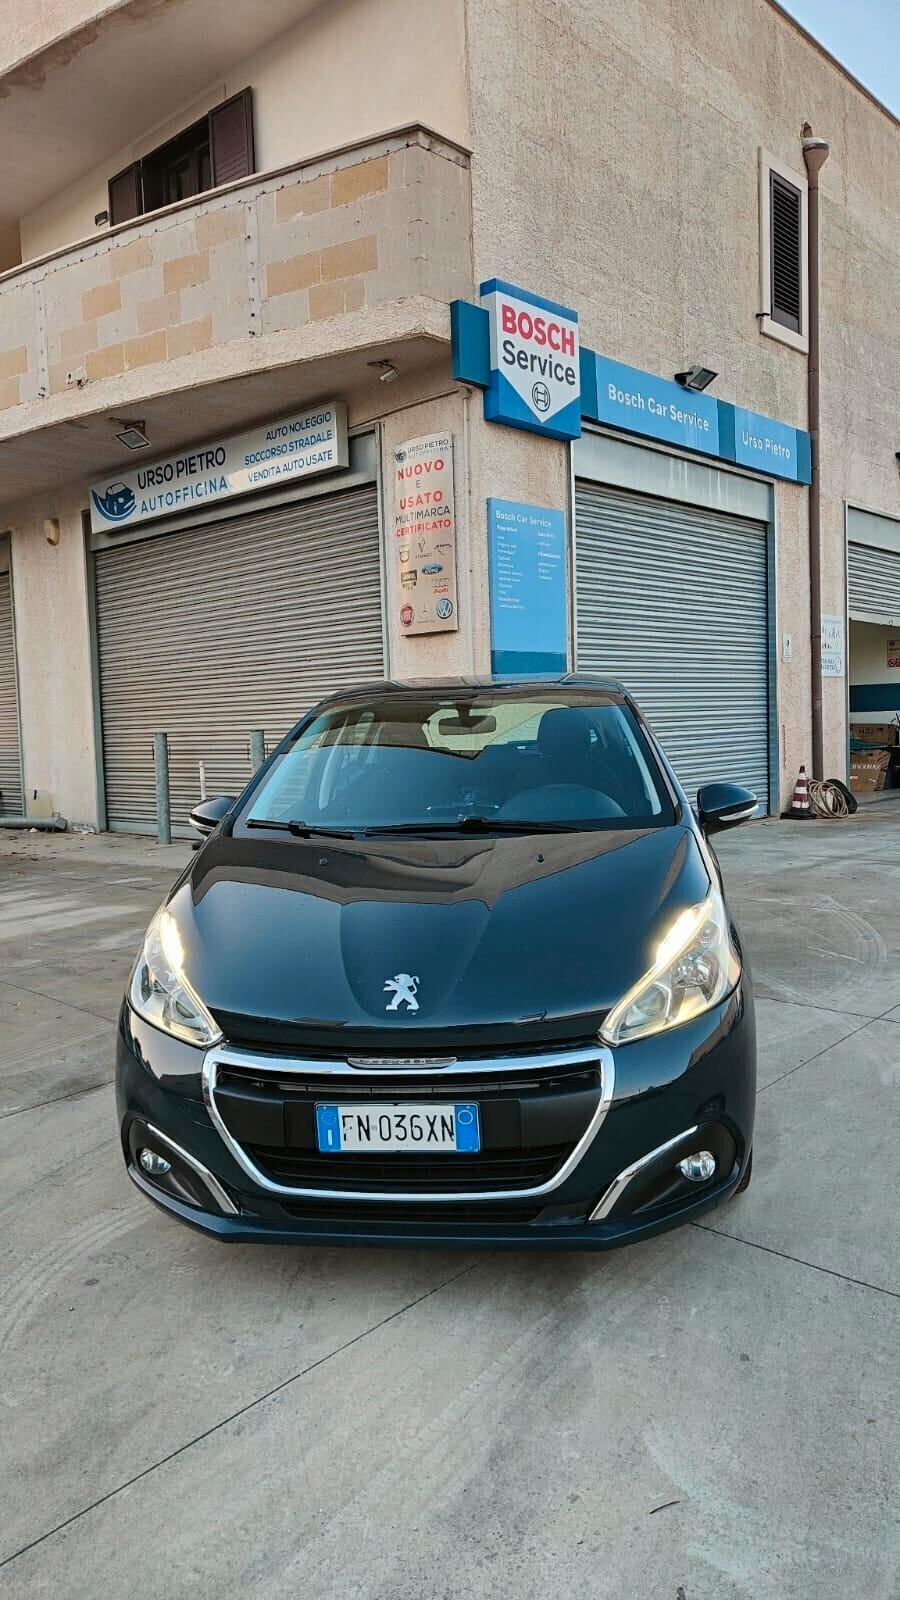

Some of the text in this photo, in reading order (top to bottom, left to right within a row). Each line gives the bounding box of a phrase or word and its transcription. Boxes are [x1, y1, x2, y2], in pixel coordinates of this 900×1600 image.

[501, 304, 575, 357] BOSCH
[502, 340, 576, 386] Service
[607, 383, 710, 432] Bosch Car Service
[266, 411, 332, 441] AUTO NOLEGGIO
[244, 429, 333, 465] SOCCORSO STRADALE
[407, 438, 449, 454] URSO PIETRO
[741, 430, 791, 459] Urso Pietro
[137, 446, 226, 490] URSO PIETRO
[248, 449, 333, 483] VENDITA AUTO USATE
[397, 459, 445, 481] NUOVO
[140, 475, 228, 514] AUTOFFICINA
[415, 479, 421, 488] E
[399, 490, 443, 510] USATO
[395, 505, 451, 526] MULTIMARCA
[396, 519, 451, 538] CERTIFICATO
[495, 510, 553, 528] Bosch Car Service
